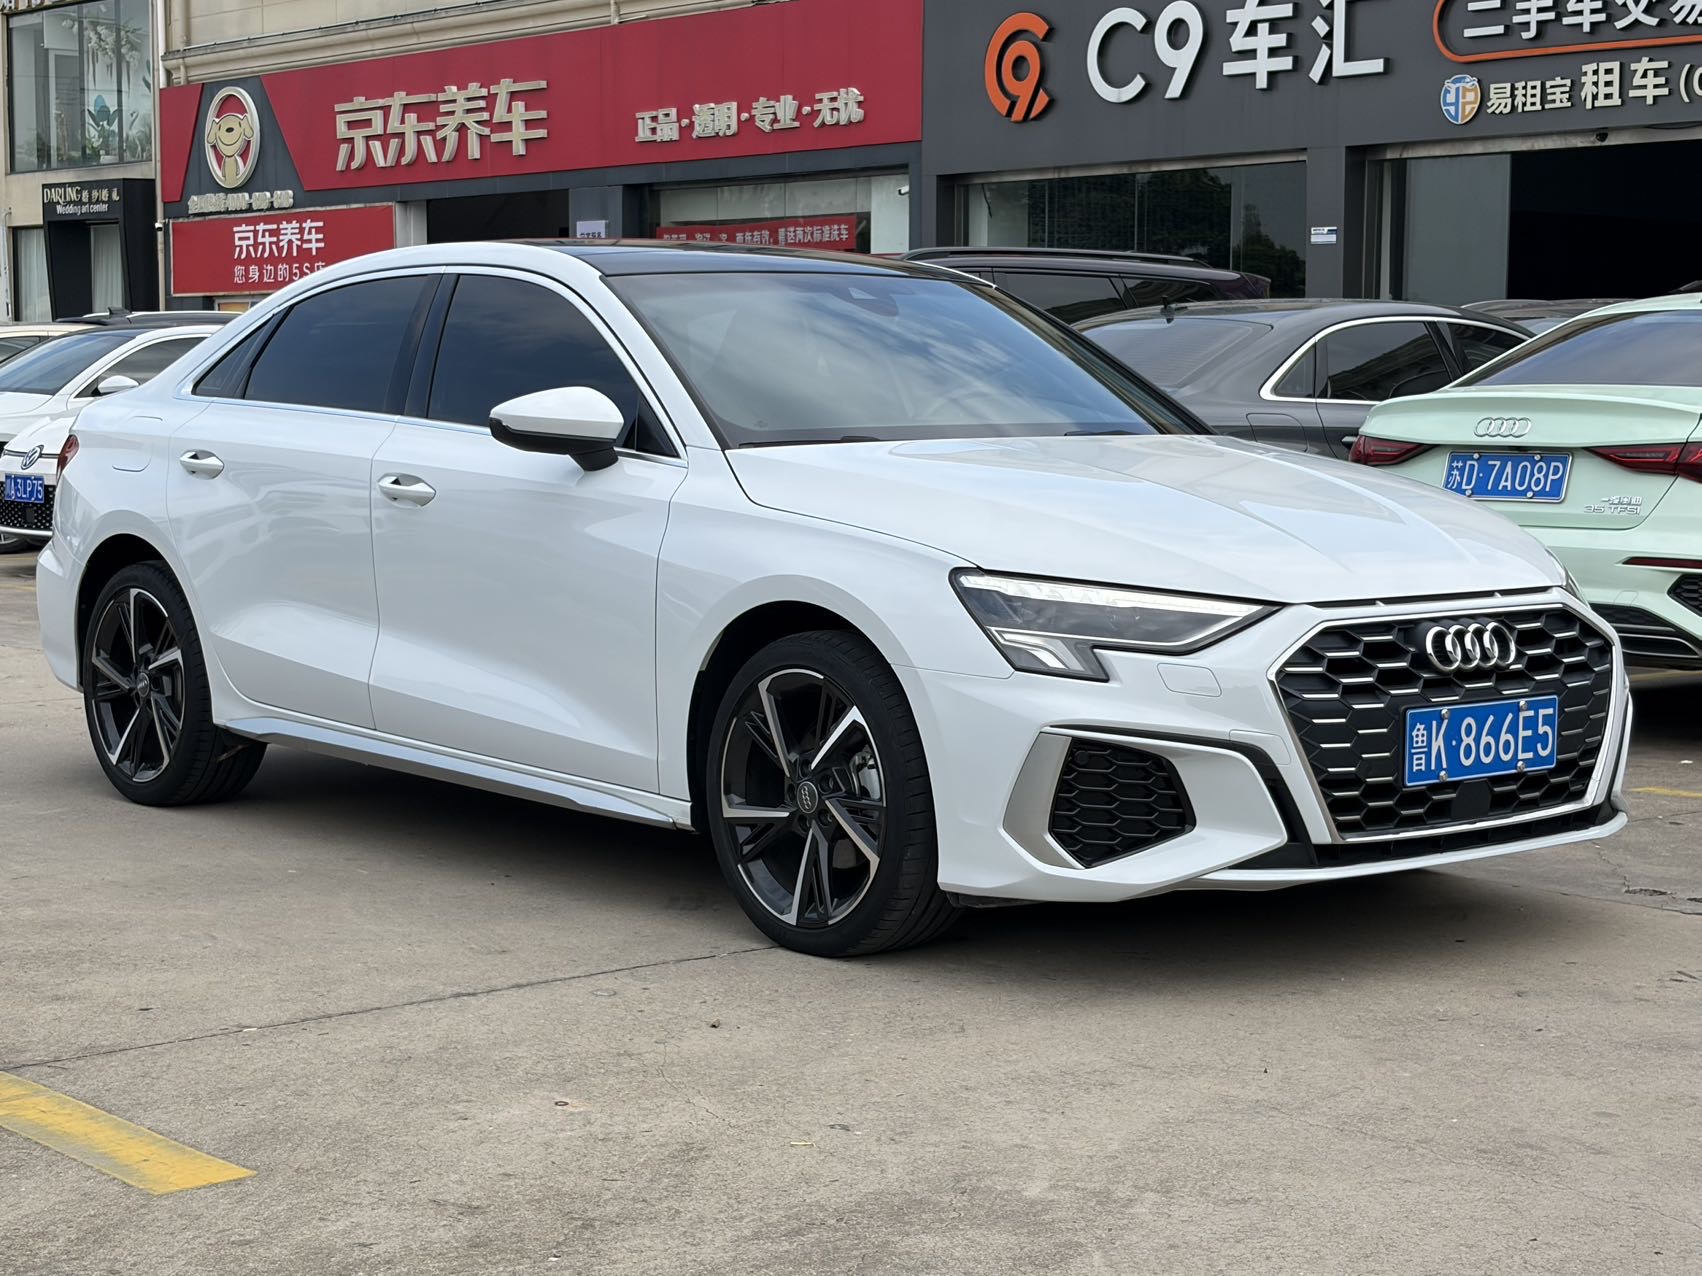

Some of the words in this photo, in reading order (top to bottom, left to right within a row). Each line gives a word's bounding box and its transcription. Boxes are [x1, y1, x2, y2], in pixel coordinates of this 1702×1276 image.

[334, 78, 548, 171] 京东养车
[43, 184, 81, 205] DARLING
[56, 203, 81, 216] Wedding
[81, 203, 90, 214] art
[90, 202, 109, 213] center
[233, 219, 325, 260] 京东养车
[1583, 504, 1605, 513] 35
[1608, 504, 1641, 516] TFSI
[1411, 707, 1554, 772] 鲁K·866E5
